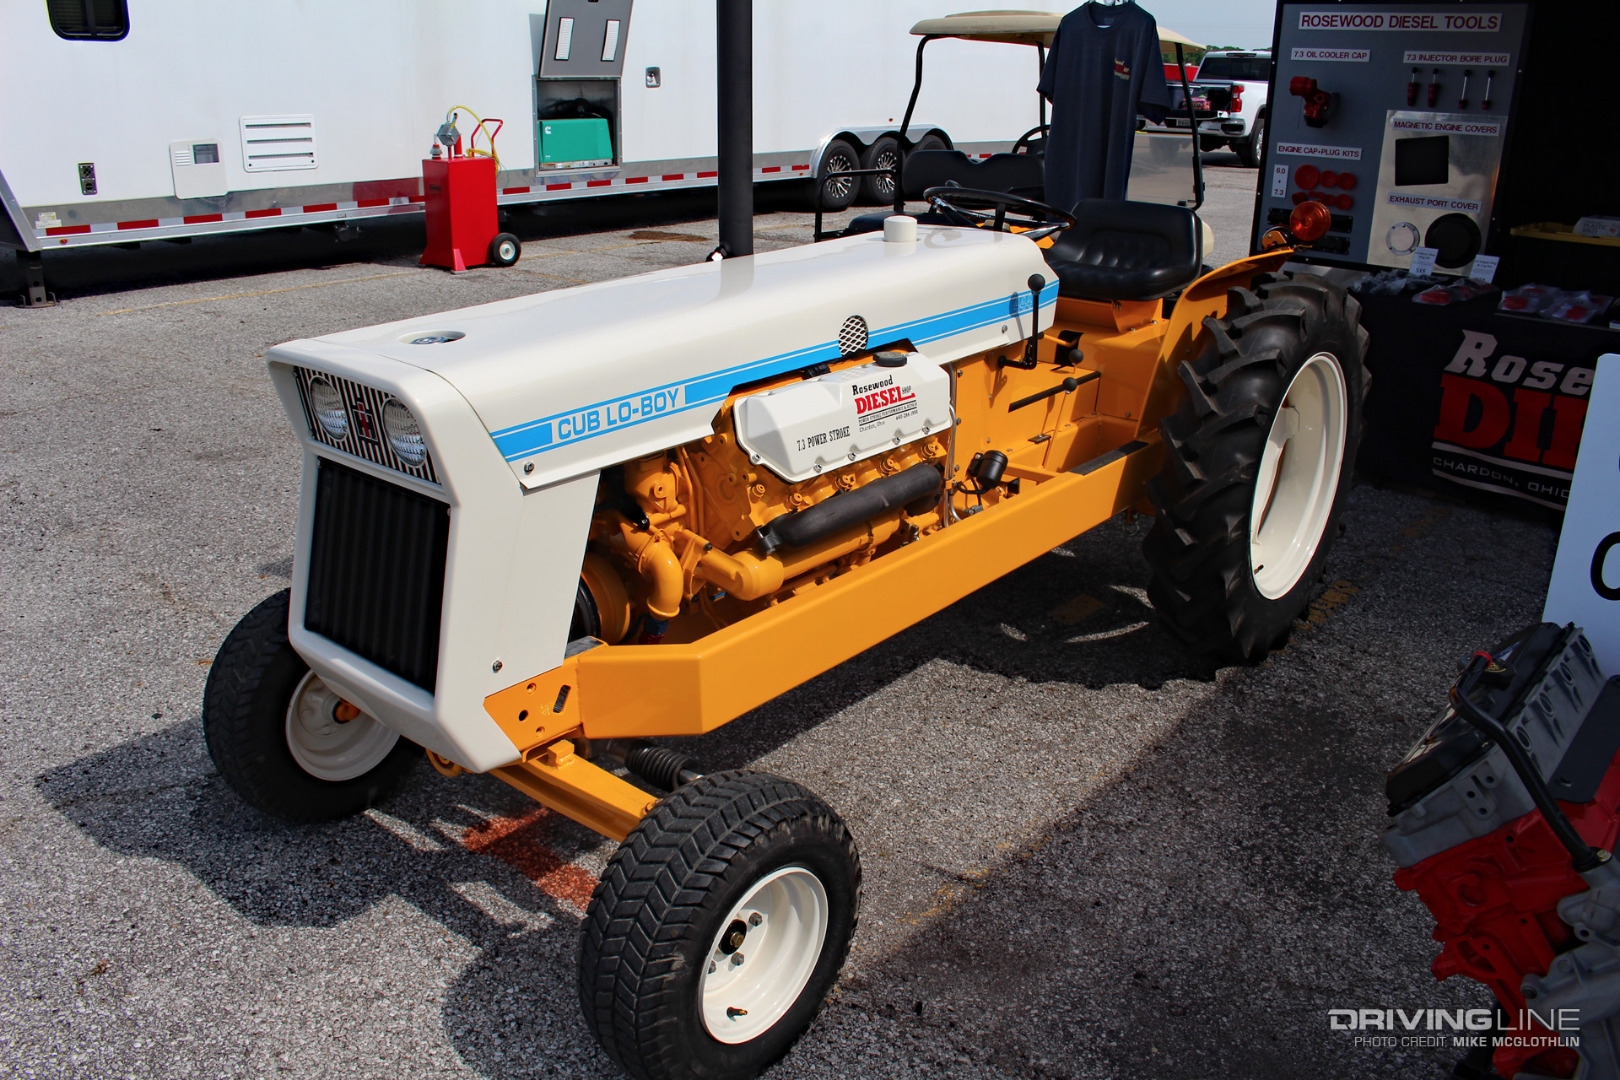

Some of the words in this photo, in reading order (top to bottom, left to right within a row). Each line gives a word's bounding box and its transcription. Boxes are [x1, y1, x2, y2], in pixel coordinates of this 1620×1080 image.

[1301, 14, 1384, 28] ROSEWOOD
[1389, 15, 1439, 28] DIESEL
[1444, 15, 1499, 29] TOOLS
[1319, 51, 1350, 59] COOLER
[1418, 54, 1458, 62] INJECTOR
[1460, 55, 1482, 63] BORE
[1484, 55, 1508, 63] PLUG
[1394, 121, 1433, 130] MAGNETIC
[1435, 123, 1463, 132] ENGINE
[1465, 125, 1498, 134] COVERS
[1278, 145, 1303, 153] ENGINE
[1342, 150, 1360, 158] KITS
[1274, 188, 1284, 196] 7.3
[1389, 195, 1425, 205] EXHAUST
[1427, 198, 1448, 208] PORT
[1451, 201, 1479, 210] COVER
[852, 374, 894, 396] Rosewood
[854, 386, 916, 415] DIESEL
[558, 410, 601, 440] CUB
[607, 387, 680, 426] LO-BOY
[796, 438, 806, 451] 7.3
[807, 432, 828, 448] POWER
[828, 425, 851, 442] STROKE
